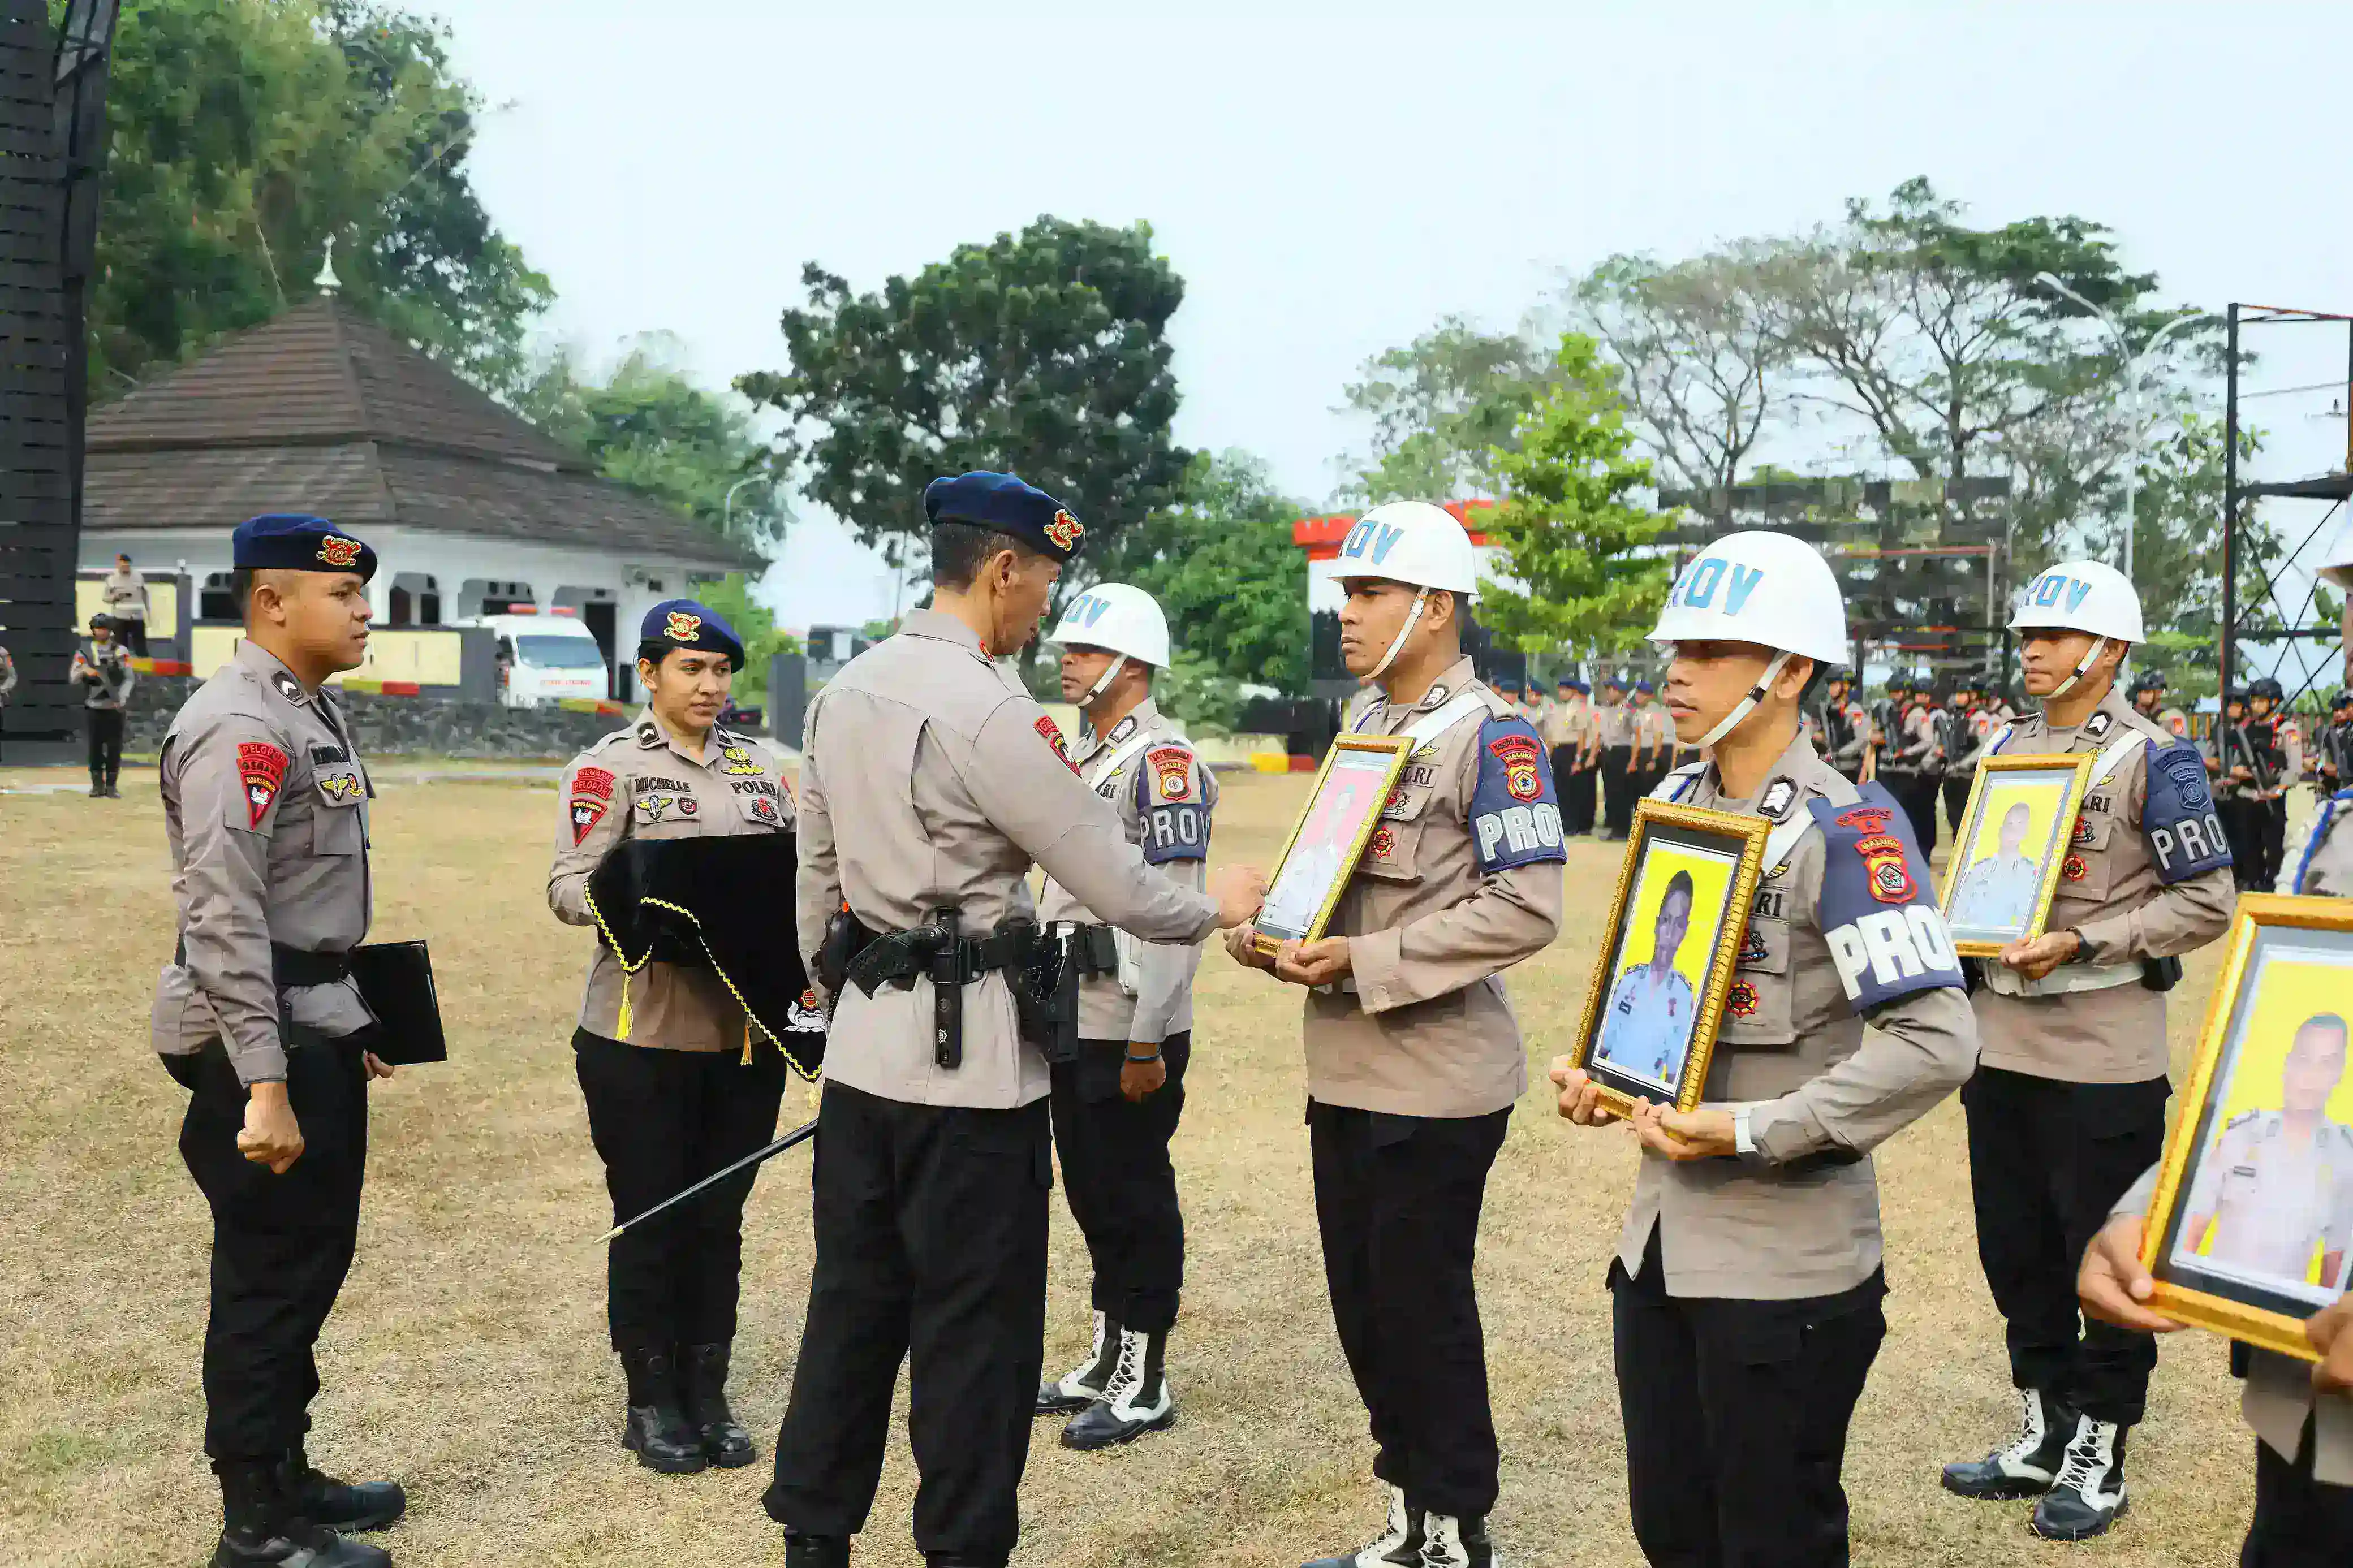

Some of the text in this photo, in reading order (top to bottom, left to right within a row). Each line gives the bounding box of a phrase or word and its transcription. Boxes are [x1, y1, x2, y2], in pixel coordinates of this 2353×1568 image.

[1344, 519, 1405, 566] OV
[1062, 595, 1111, 628] OV
[635, 776, 691, 792] MICHELLE
[730, 780, 777, 797] POLRI
[1755, 892, 1782, 917] RI
